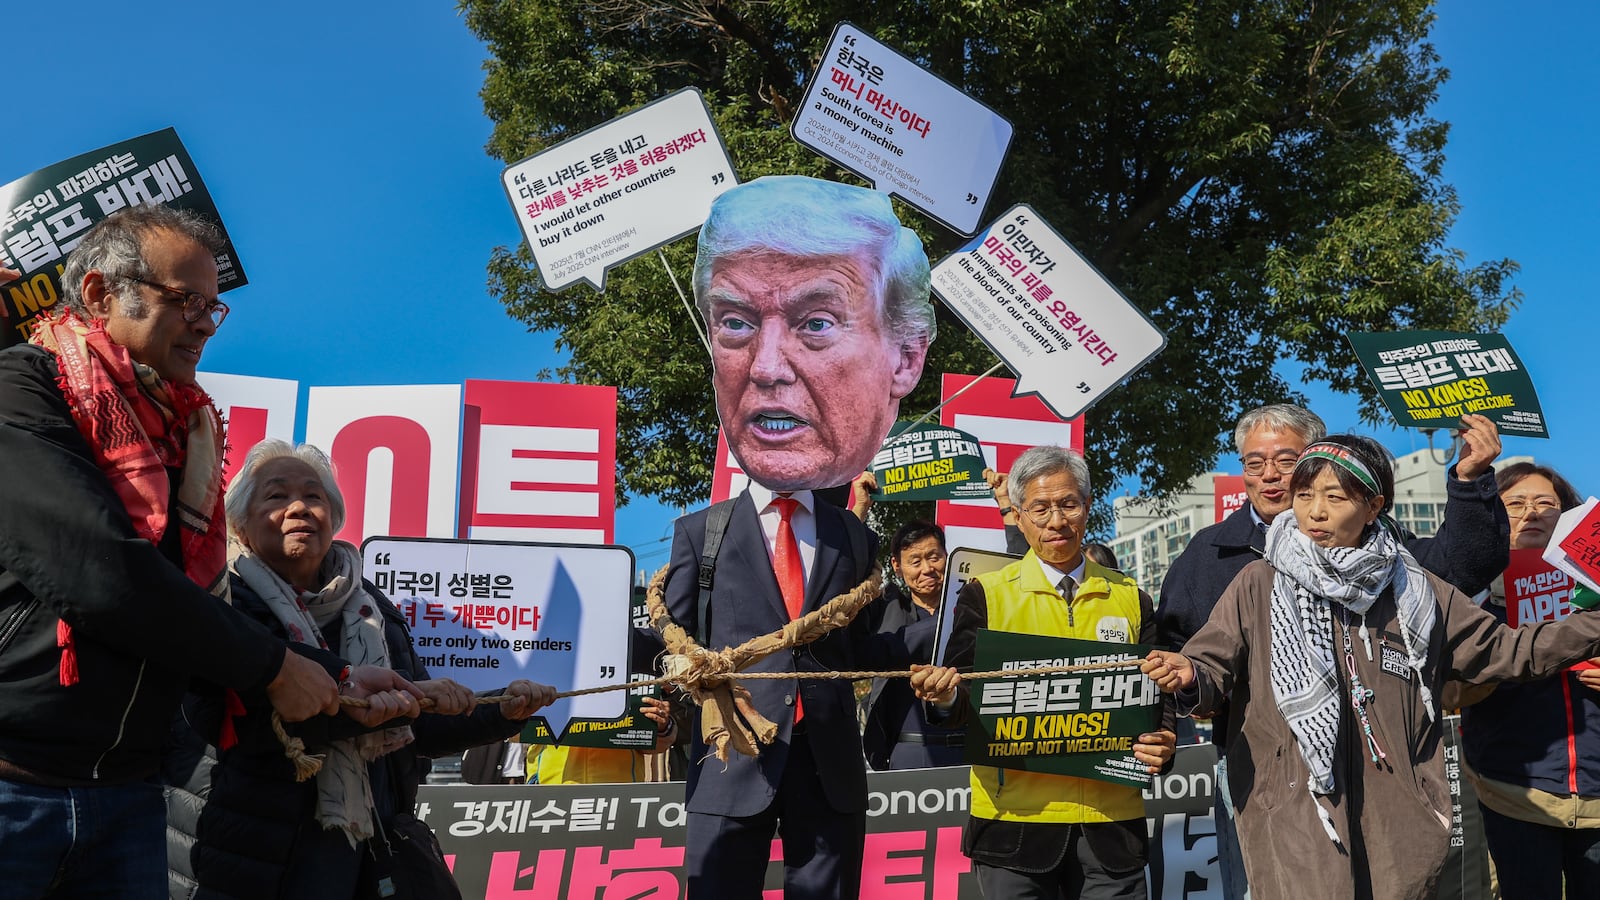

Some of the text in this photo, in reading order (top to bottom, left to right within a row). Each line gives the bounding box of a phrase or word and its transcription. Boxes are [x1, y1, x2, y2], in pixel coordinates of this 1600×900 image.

[836, 46, 884, 86] 한국은
[815, 102, 904, 156] a money machine
[820, 87, 894, 135] South Korea is
[866, 88, 930, 139] 머신'이다
[808, 118, 831, 136] 2024년
[832, 130, 846, 144] 10월
[847, 140, 866, 155] 시카고
[57, 152, 138, 202] 파괴하는
[519, 134, 648, 199] 다른 나라도 돈을 내고
[526, 128, 706, 218] 관세를 낮추는 것을 허용하겠다
[817, 134, 834, 147] 2024
[834, 144, 864, 165] Economic
[864, 160, 878, 172] Club
[886, 172, 908, 190] Chicago
[908, 187, 936, 205] interview
[534, 166, 676, 234] I would let other countries
[539, 213, 605, 248] buy it down
[549, 226, 637, 271] 2025년 7월 CNN 인터뷰에서
[1003, 224, 1056, 274] 이민자가
[553, 242, 630, 280] July 2025 CNN interview
[10, 273, 58, 318] NO
[958, 258, 1056, 354] the blood of our country
[970, 248, 1072, 351] Immigrants are poisoning
[984, 236, 1118, 366] 미국의 피를 오염시킨다
[1374, 348, 1518, 390] 트럼프 반대!
[1378, 339, 1481, 364] 민주주의 파괴하는
[1400, 377, 1492, 408] NO KINGS!
[1408, 394, 1515, 420] TRUMP NOT WELCOME
[924, 430, 962, 440] 파괴하는
[873, 440, 980, 471] 트럼프 반대!
[885, 458, 954, 484] NO KINGS!
[882, 471, 970, 496] TRUMP NOT WELCOME
[375, 570, 514, 599] 미국의 성별은
[423, 604, 446, 628] 두
[451, 604, 542, 632] 개뿐이다
[1100, 629, 1124, 642] 정의당
[418, 636, 442, 647] are
[446, 635, 478, 650] only
[481, 636, 510, 649] two
[512, 638, 572, 652] genders
[450, 654, 500, 669] female
[1384, 662, 1409, 678] CREW
[980, 674, 1160, 715] 트럼프 반대!
[995, 712, 1110, 741] NO KINGS!
[988, 736, 1132, 757] TRUMP NOT WELCOME
[449, 797, 619, 836] 경제수탈!
